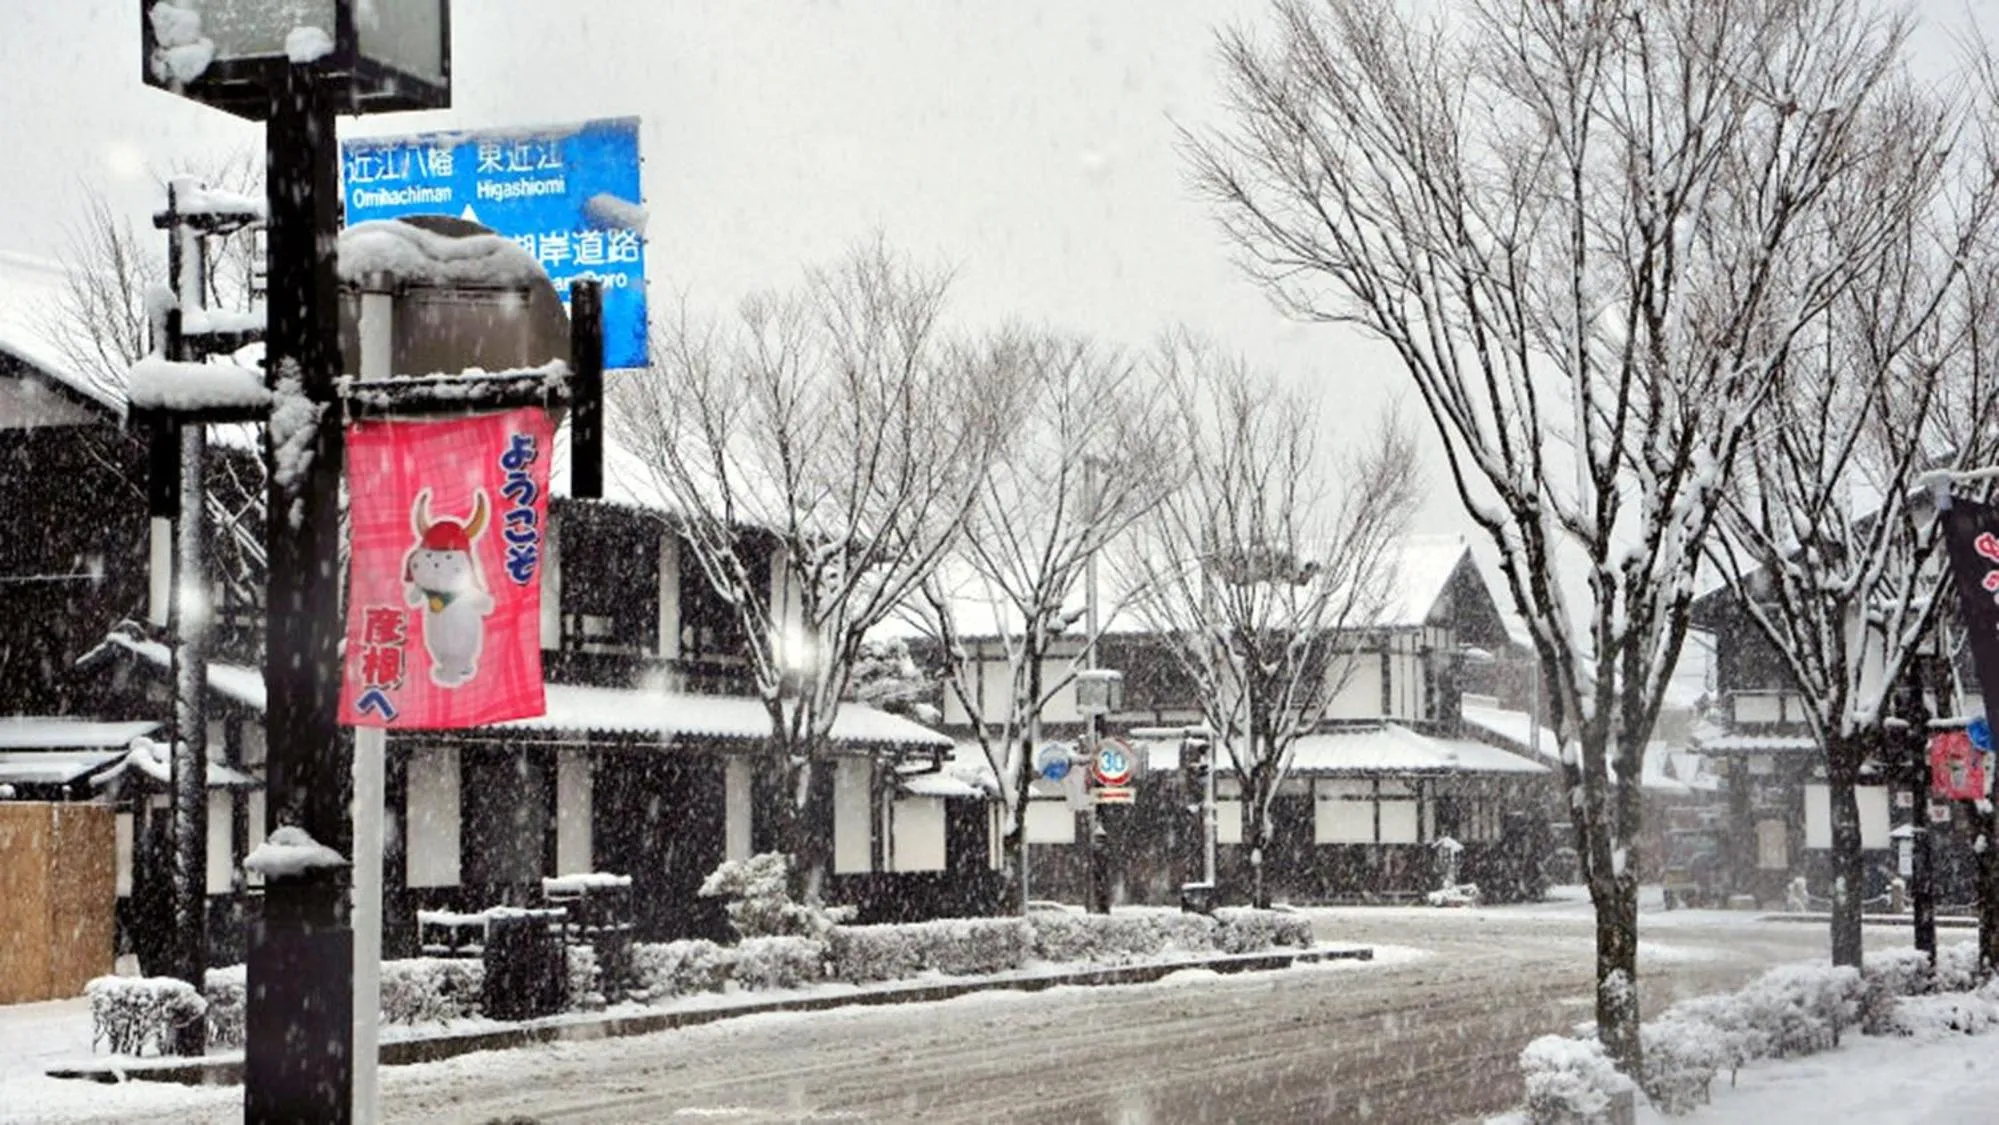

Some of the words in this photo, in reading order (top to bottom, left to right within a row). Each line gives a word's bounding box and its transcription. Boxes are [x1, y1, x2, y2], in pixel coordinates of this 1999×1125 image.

[347, 147, 454, 184] 近江八幡
[477, 143, 564, 174] 東近江
[353, 186, 452, 208] Omihachiman
[477, 175, 565, 201] Higashiomi
[501, 434, 537, 583] ようこそ
[1101, 751, 1125, 772] 30
